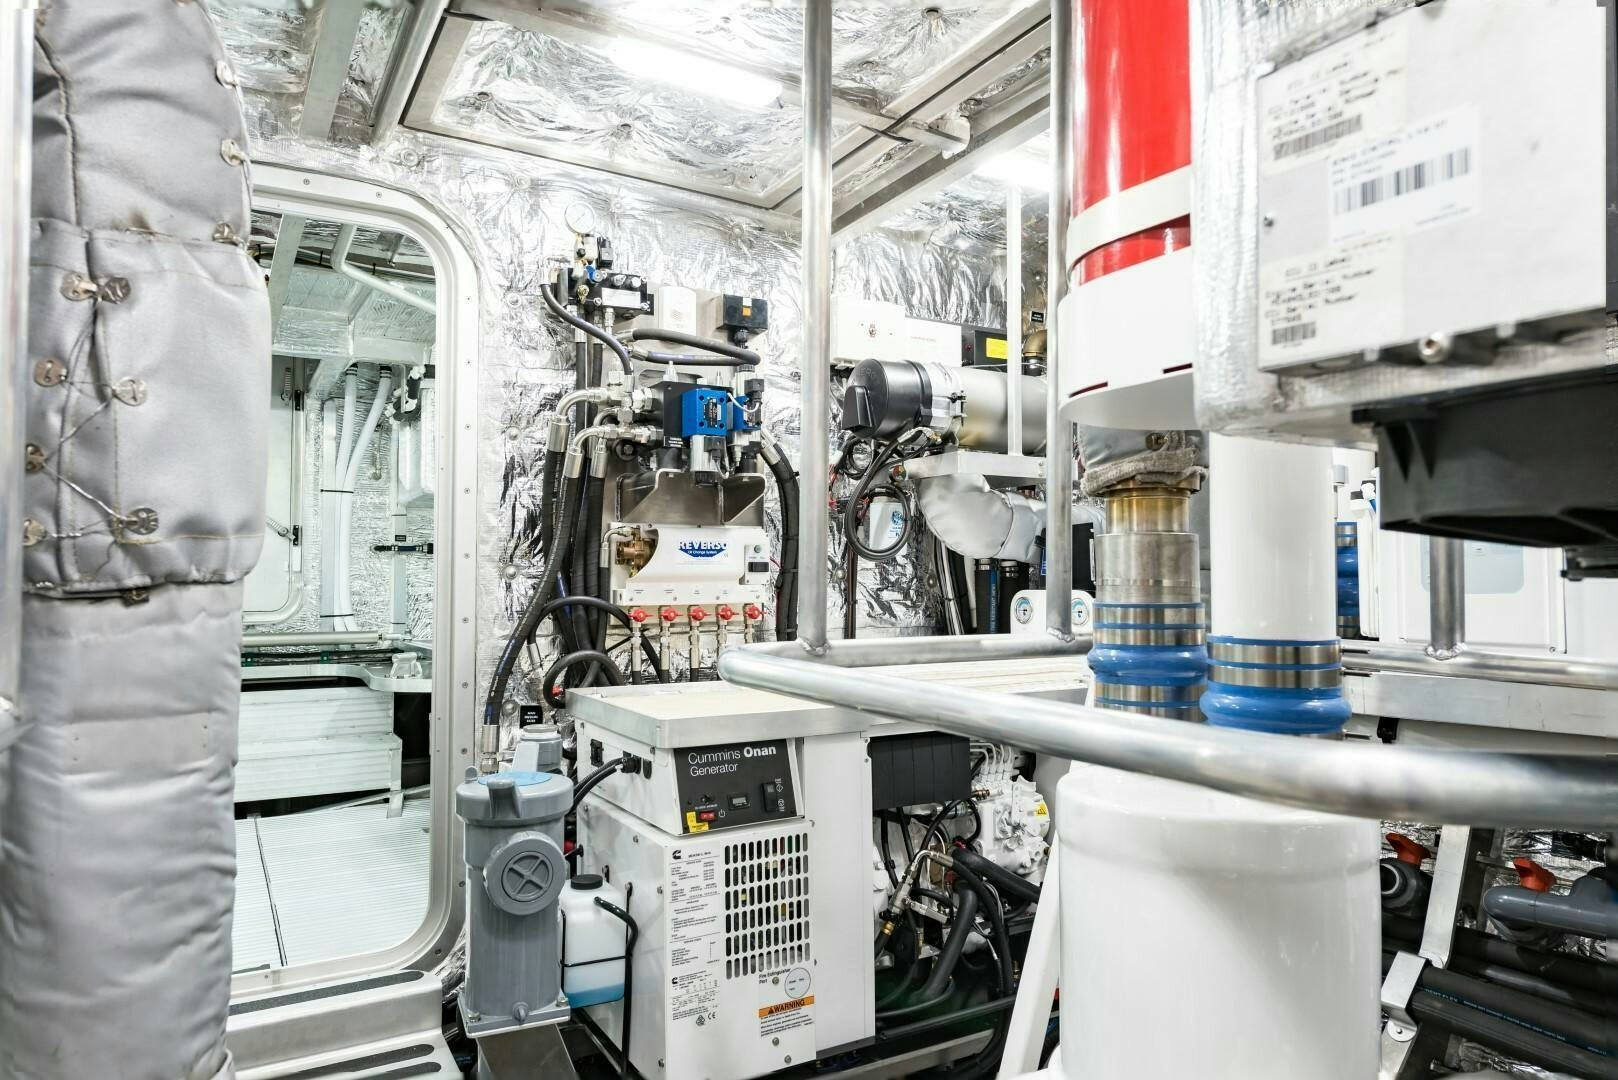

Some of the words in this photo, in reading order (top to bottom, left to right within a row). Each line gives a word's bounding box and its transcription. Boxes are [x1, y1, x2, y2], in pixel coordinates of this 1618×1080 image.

[677, 540, 728, 550] REVERSO
[688, 748, 741, 765] Cummins
[743, 746, 777, 758] Onan
[690, 763, 738, 777] Generator
[773, 998, 805, 1013] WARNING
